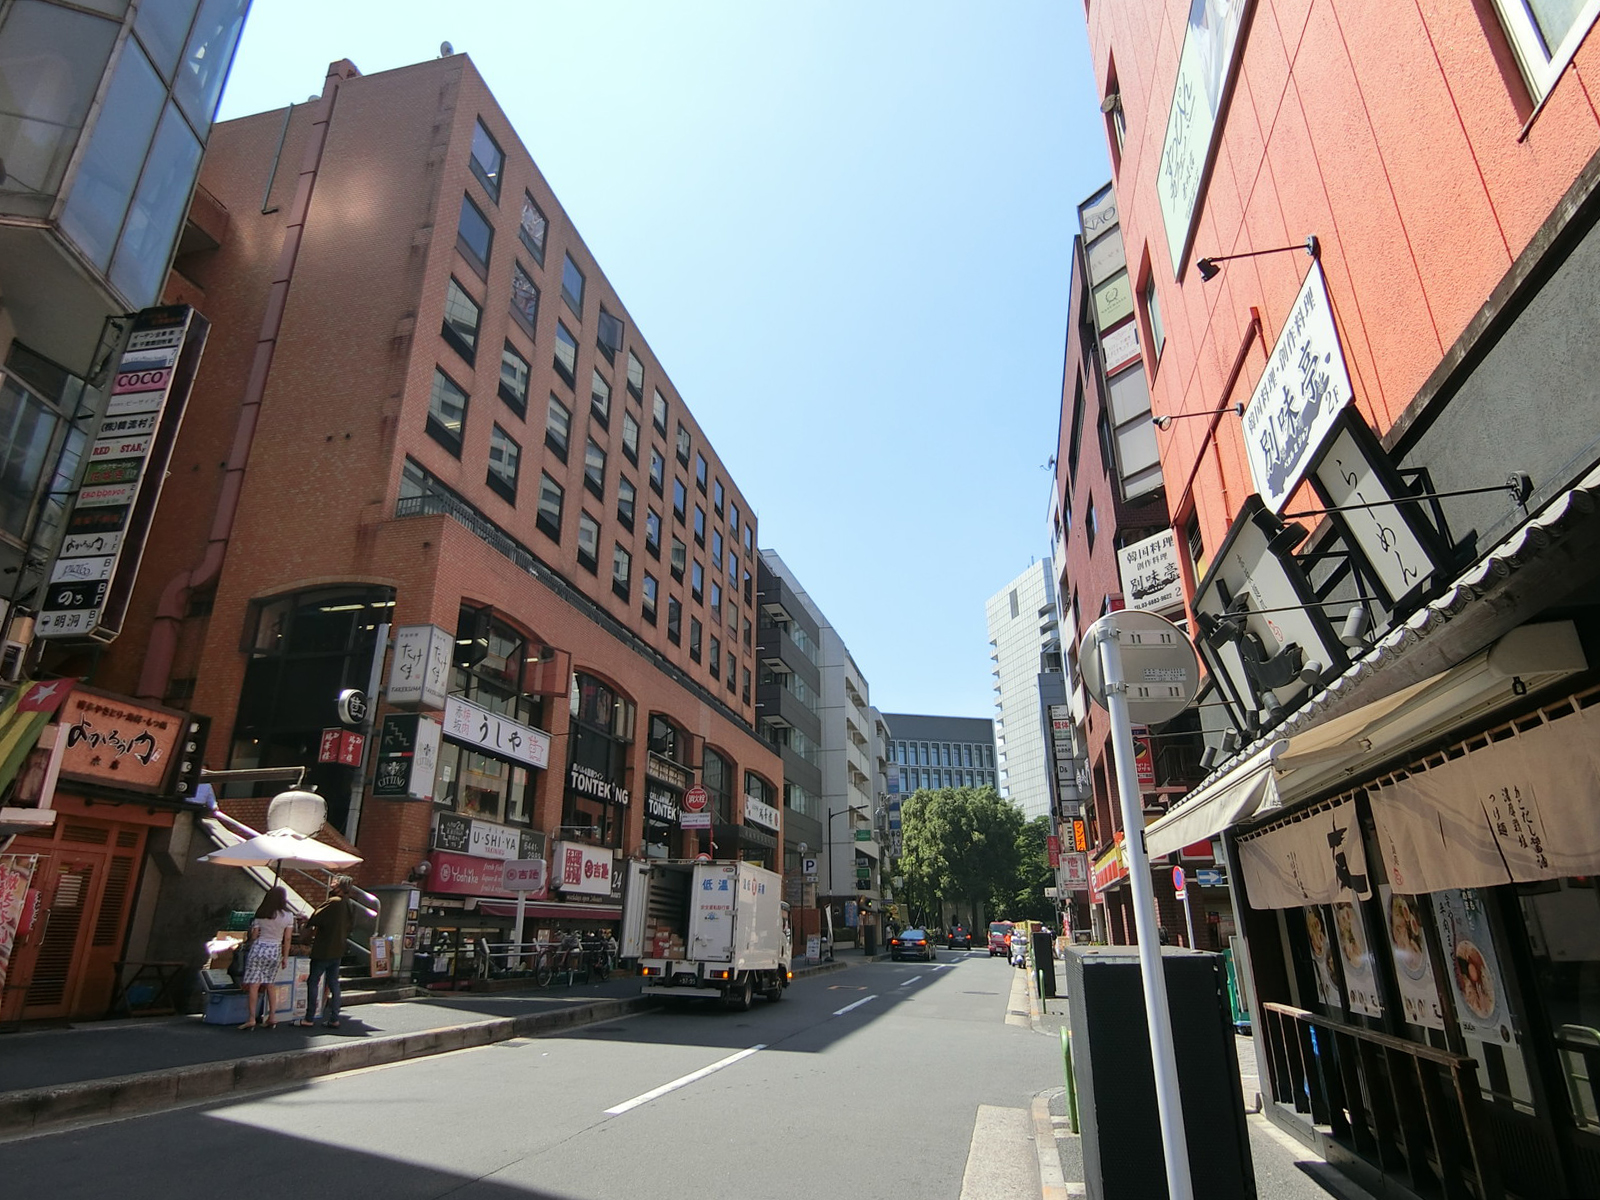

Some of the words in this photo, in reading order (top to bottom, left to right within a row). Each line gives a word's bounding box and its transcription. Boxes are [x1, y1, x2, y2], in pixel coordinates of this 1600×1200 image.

[1248, 286, 1316, 435] 韓国料理・創作料理
[118, 371, 164, 388] COCO
[1259, 340, 1320, 473] 別味亭
[1325, 384, 1341, 415] 2F
[93, 446, 111, 456] RED
[120, 443, 142, 453] STAR
[1336, 459, 1417, 587] らーめん
[1126, 535, 1174, 564] 韓国料理
[1130, 562, 1179, 594] 別味亭
[480, 714, 522, 753] うしや
[1054, 721, 1069, 730] 整体
[1488, 794, 1509, 837] つけ麺
[612, 871, 622, 888] 24
[805, 860, 815, 872] P
[702, 879, 729, 891] 低温
